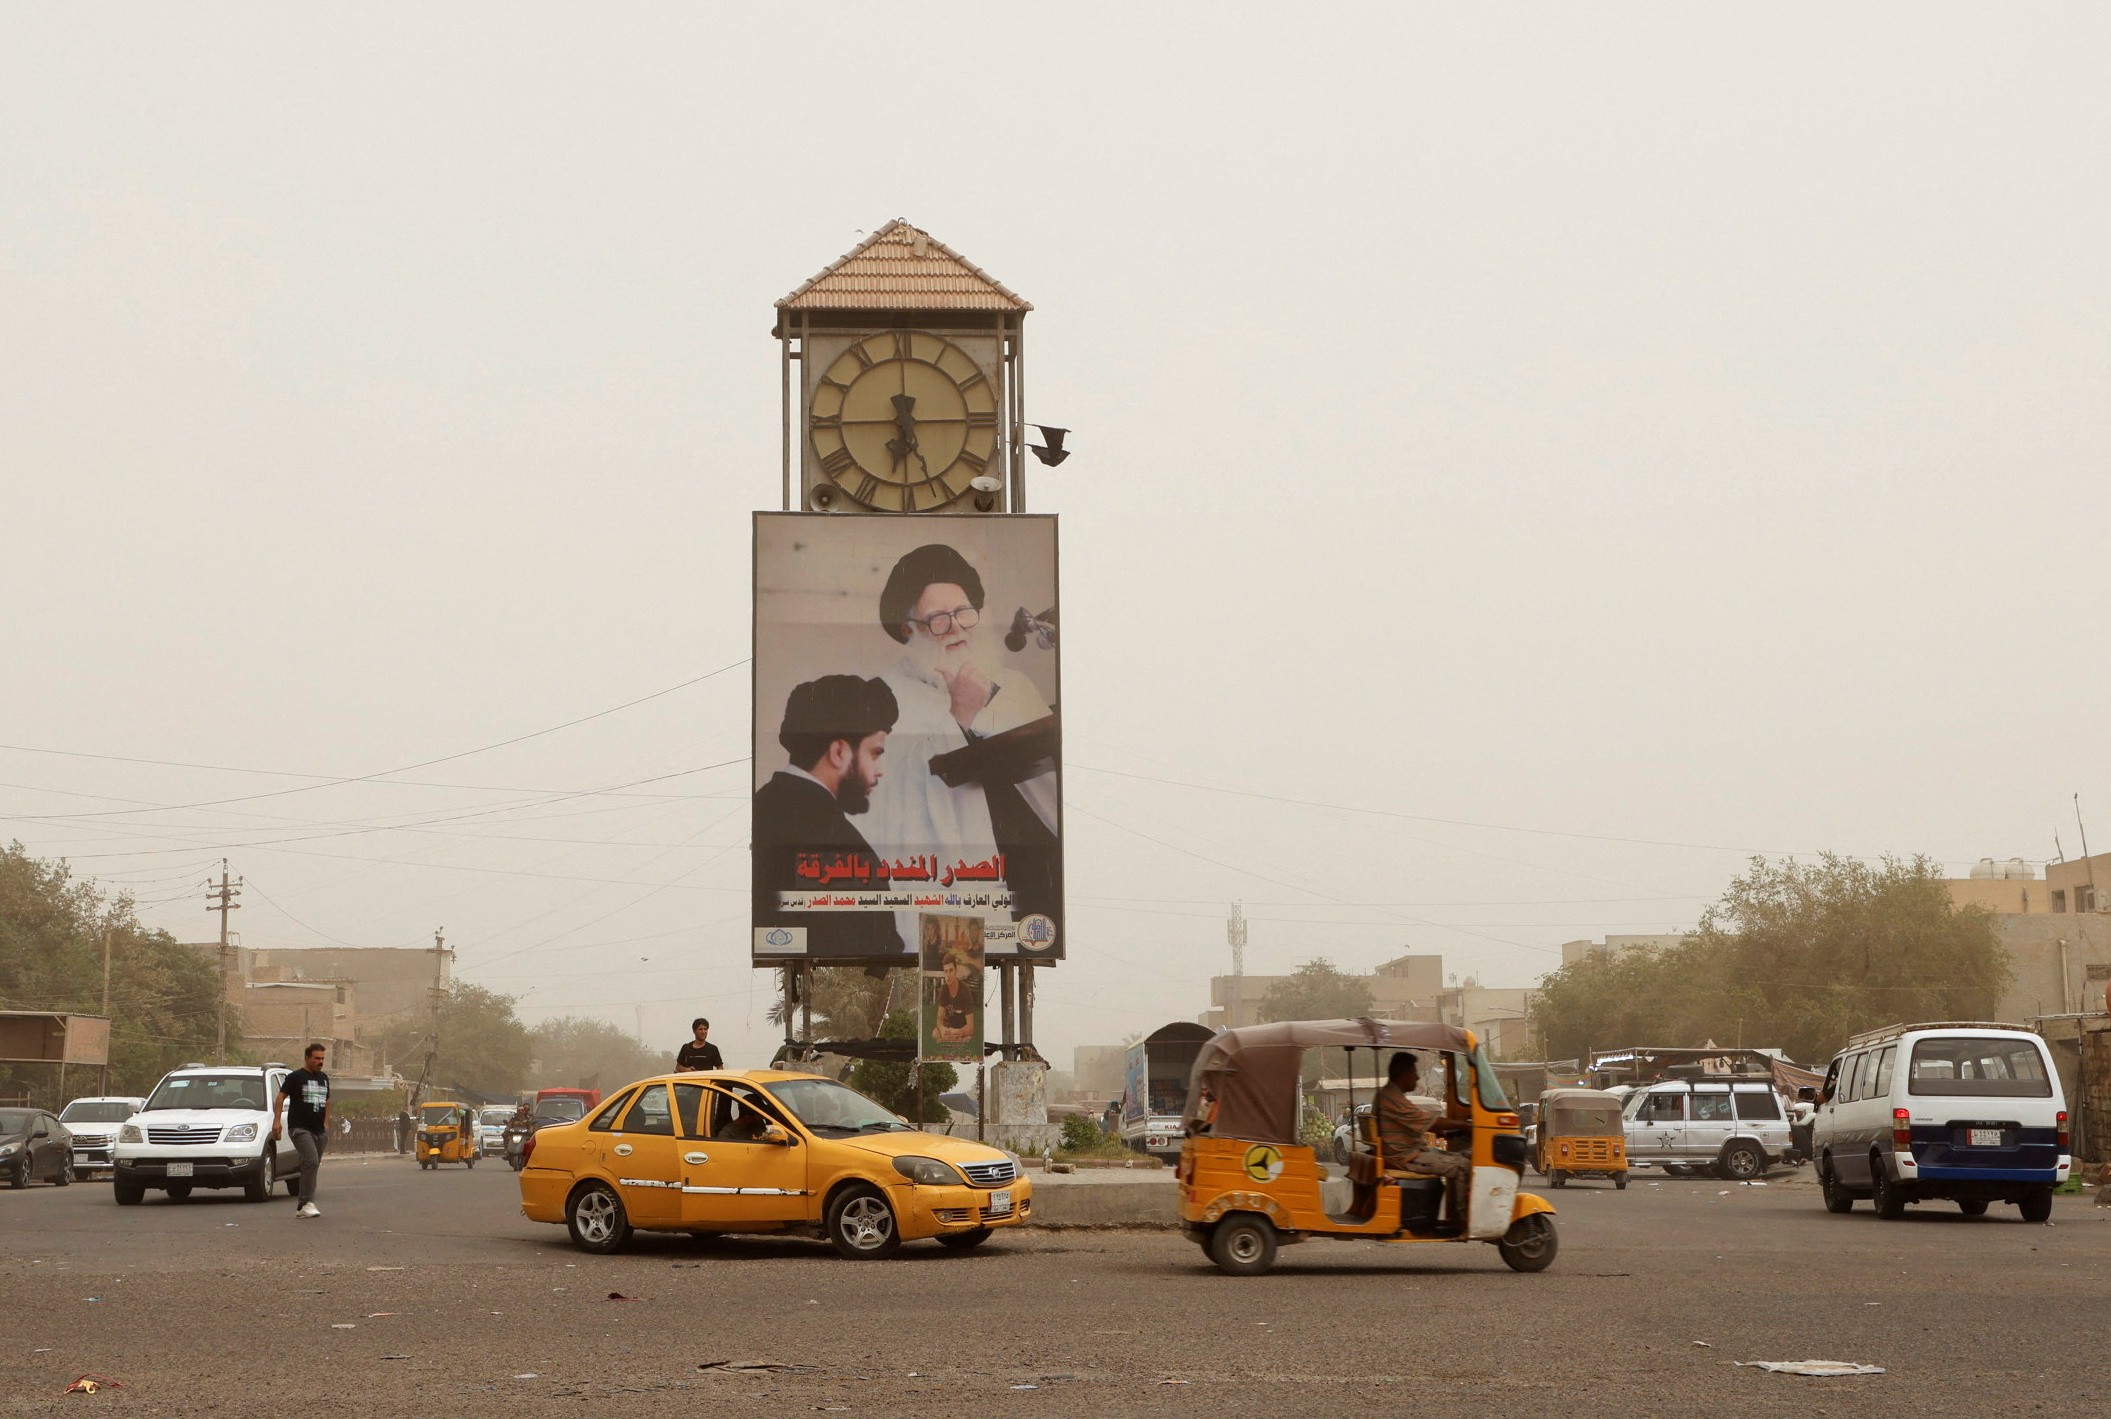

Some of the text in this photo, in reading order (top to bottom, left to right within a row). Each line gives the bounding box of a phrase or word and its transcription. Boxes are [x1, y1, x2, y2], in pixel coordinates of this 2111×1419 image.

[797, 853, 1007, 887] الصدر المندد بالفرقة
[807, 895, 832, 909] الصدر
[833, 895, 856, 908] محمد
[857, 894, 882, 909] السيد
[883, 893, 913, 909] السعيد
[914, 893, 944, 908] الشهيد
[944, 892, 962, 908] بالله
[963, 894, 990, 908] العارف
[991, 894, 1015, 911] الولي
